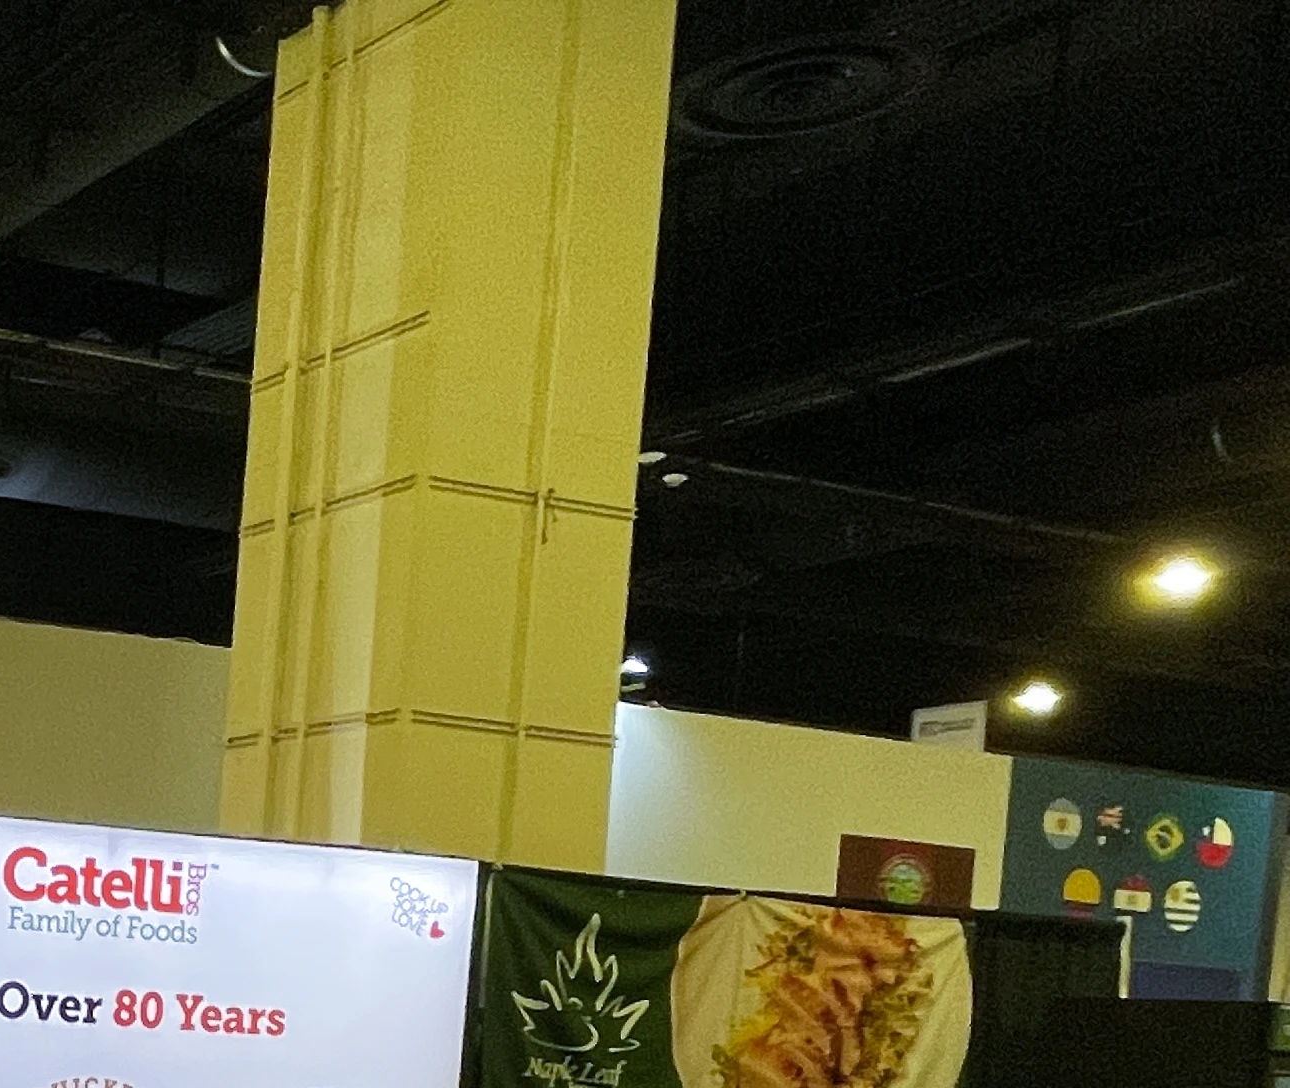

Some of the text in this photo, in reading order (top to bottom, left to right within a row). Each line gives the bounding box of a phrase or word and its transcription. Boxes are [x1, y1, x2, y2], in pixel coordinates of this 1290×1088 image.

[3, 846, 183, 914] Catelli
[185, 862, 207, 917] Bros
[390, 876, 430, 906] COOK
[7, 905, 198, 944] Family of Foods
[112, 990, 164, 1029] 80
[177, 993, 286, 1037] Years
